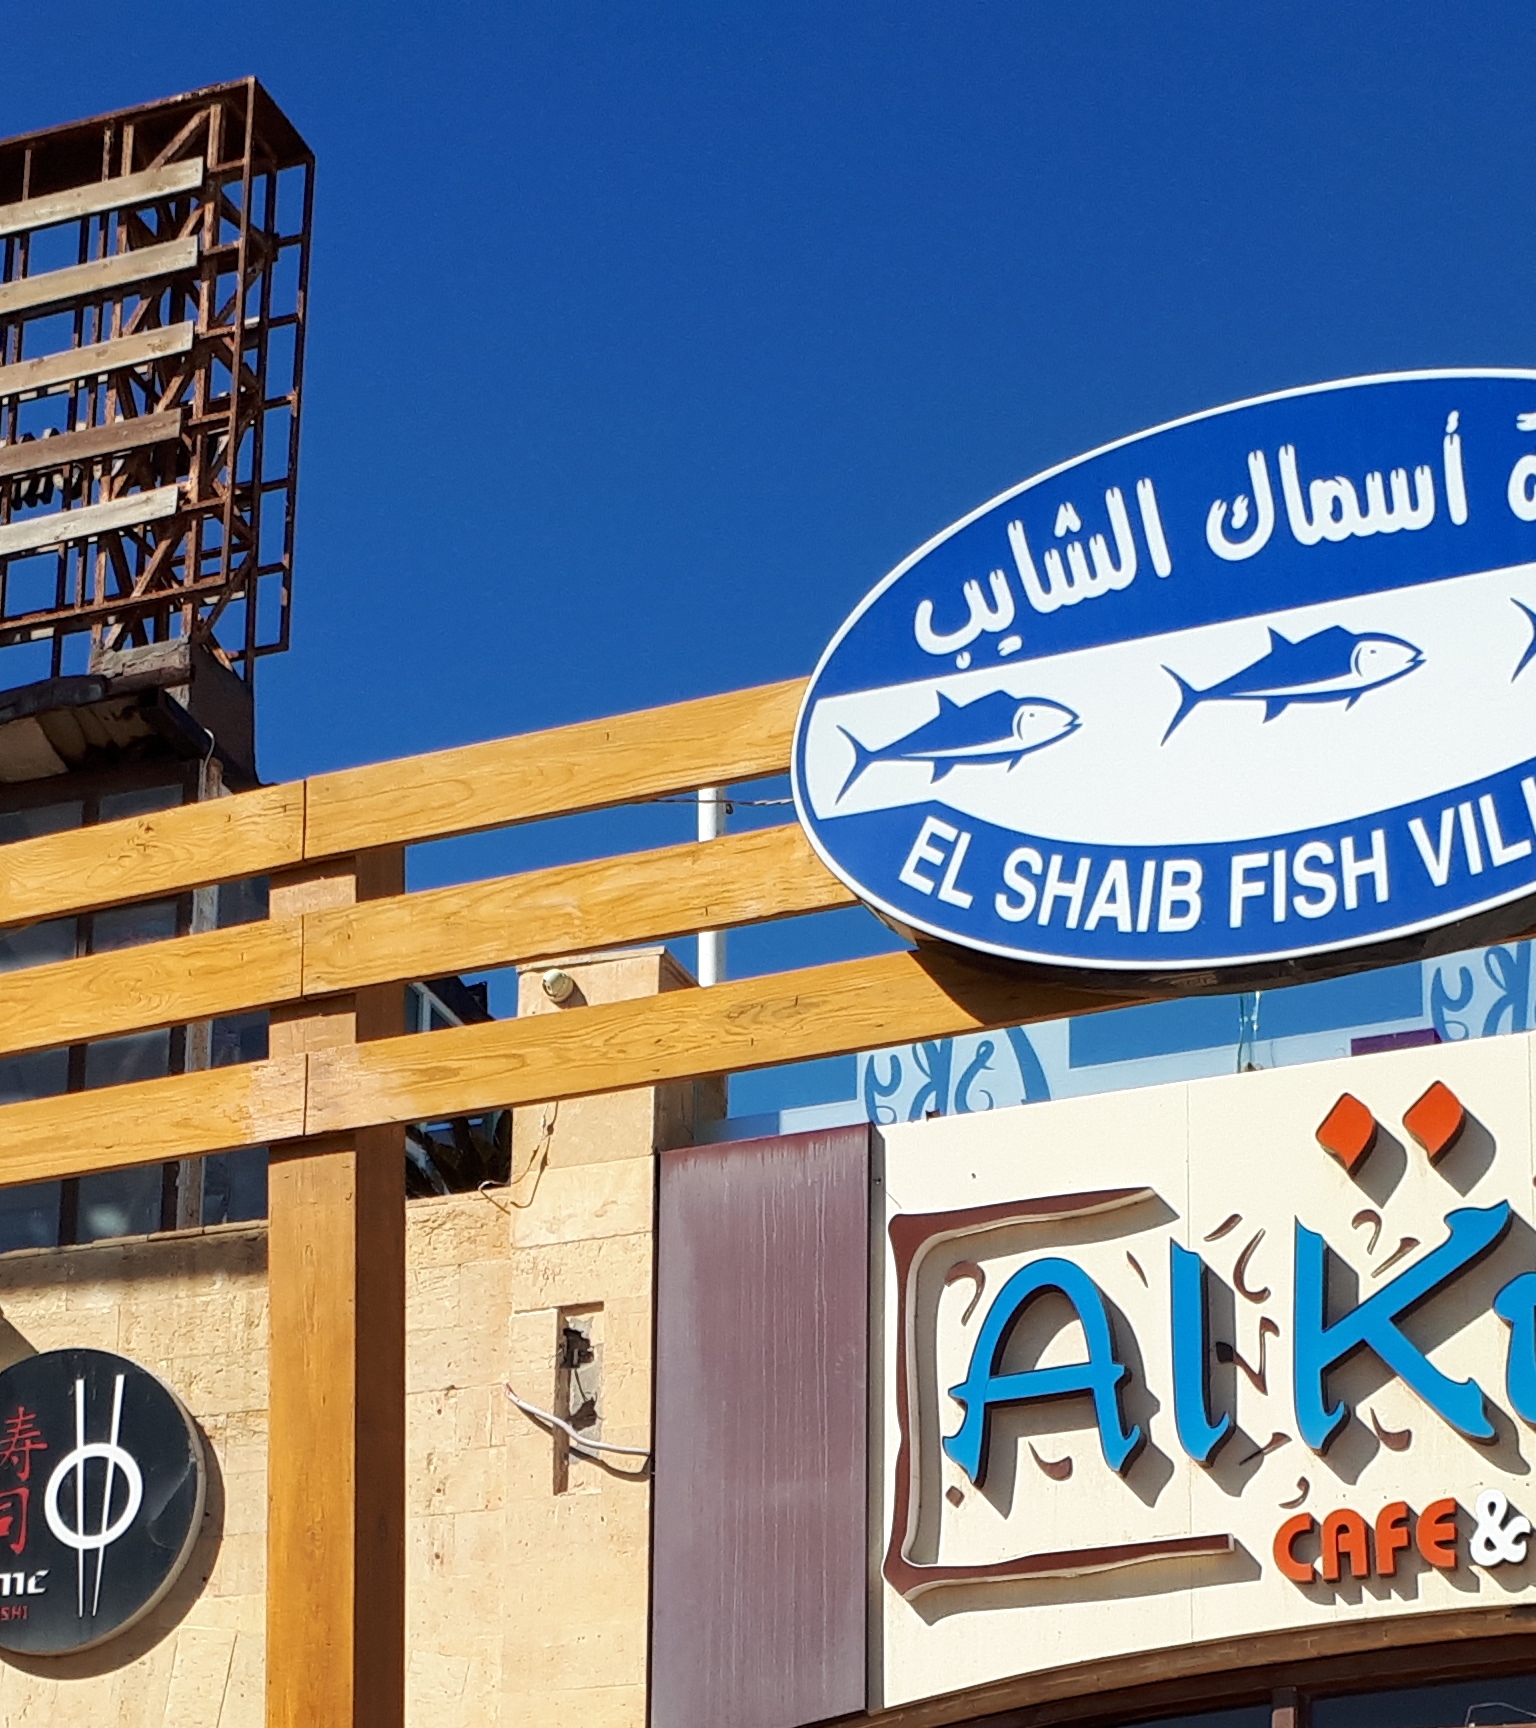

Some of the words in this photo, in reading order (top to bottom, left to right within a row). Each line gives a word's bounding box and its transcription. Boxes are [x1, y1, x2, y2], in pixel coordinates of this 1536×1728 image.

[1205, 411, 1467, 563] أسماك
[913, 476, 1174, 670] الشايب
[898, 814, 975, 911] EL
[995, 845, 1203, 936] SHAIB
[1228, 829, 1387, 931] FISH
[1273, 1497, 1458, 1584] CAFE
[1470, 1488, 1531, 1568] &
